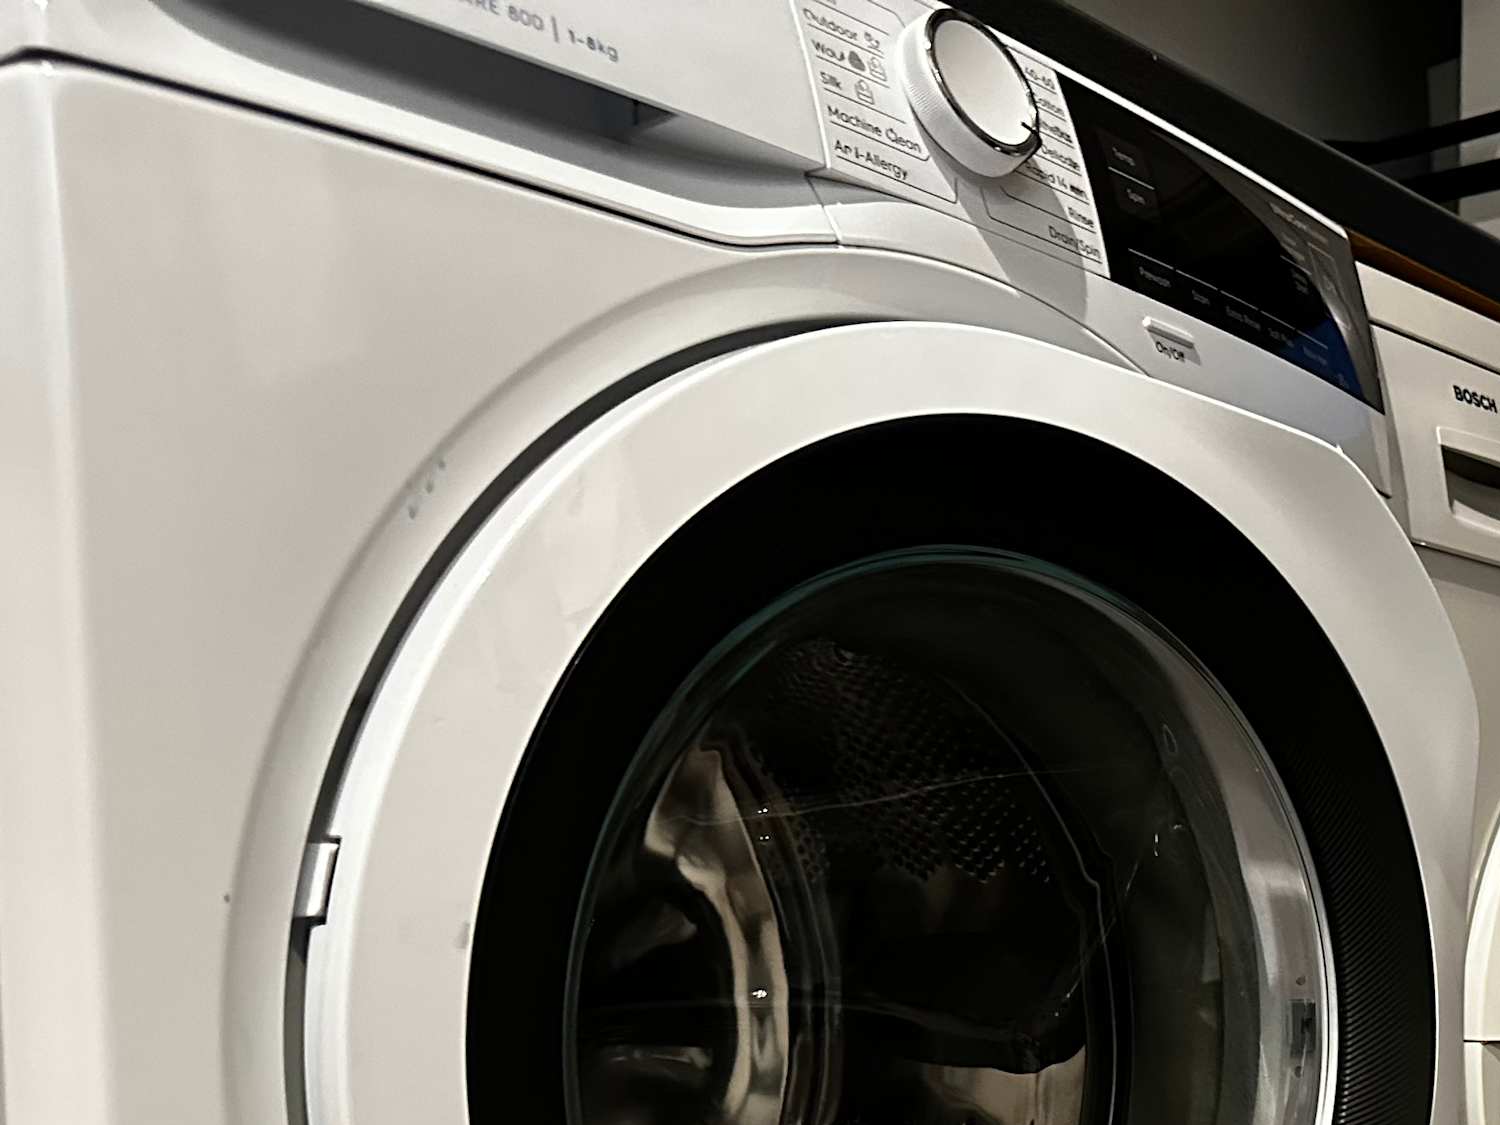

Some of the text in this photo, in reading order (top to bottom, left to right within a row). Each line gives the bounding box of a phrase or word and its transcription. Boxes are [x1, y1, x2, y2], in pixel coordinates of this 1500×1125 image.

[508, 6, 544, 30] 800
[568, 29, 619, 62] 1-8kg
[827, 105, 922, 153] Machine Clean
[1453, 385, 1498, 414] BOSCH
